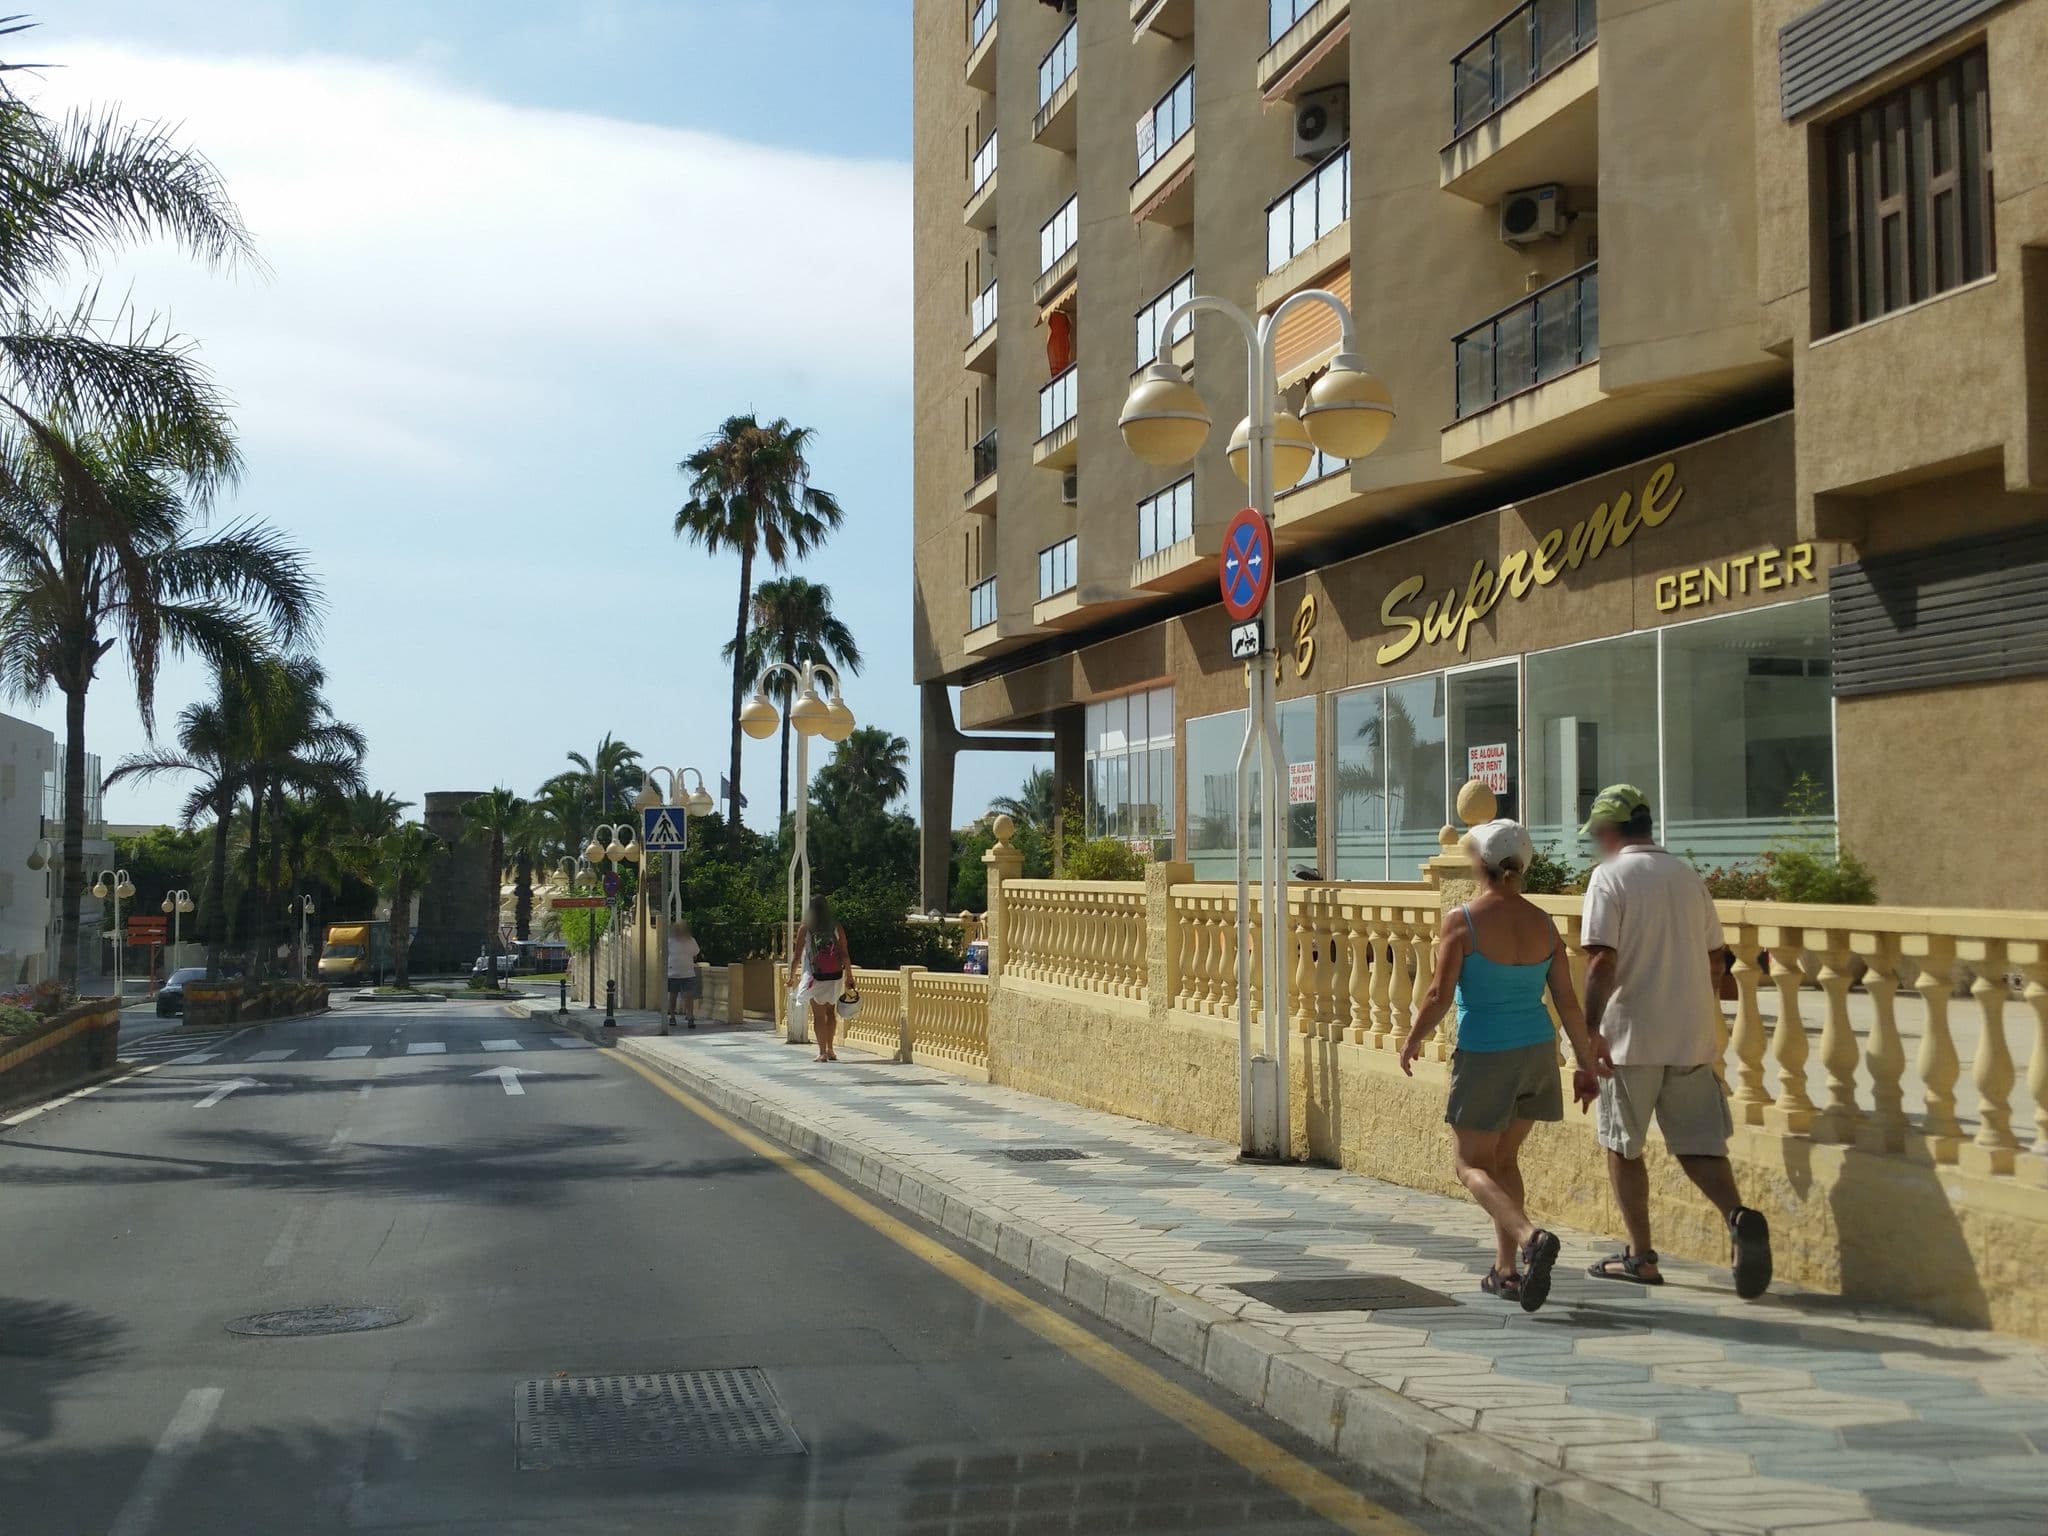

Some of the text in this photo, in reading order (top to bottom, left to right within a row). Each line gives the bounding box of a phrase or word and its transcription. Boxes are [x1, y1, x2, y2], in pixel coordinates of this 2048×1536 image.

[1376, 461, 1684, 667] Supreme
[1655, 543, 1816, 612] CENTER
[1470, 747, 1504, 760] SE ALQUILA
[1473, 759, 1502, 772] FOR RENT
